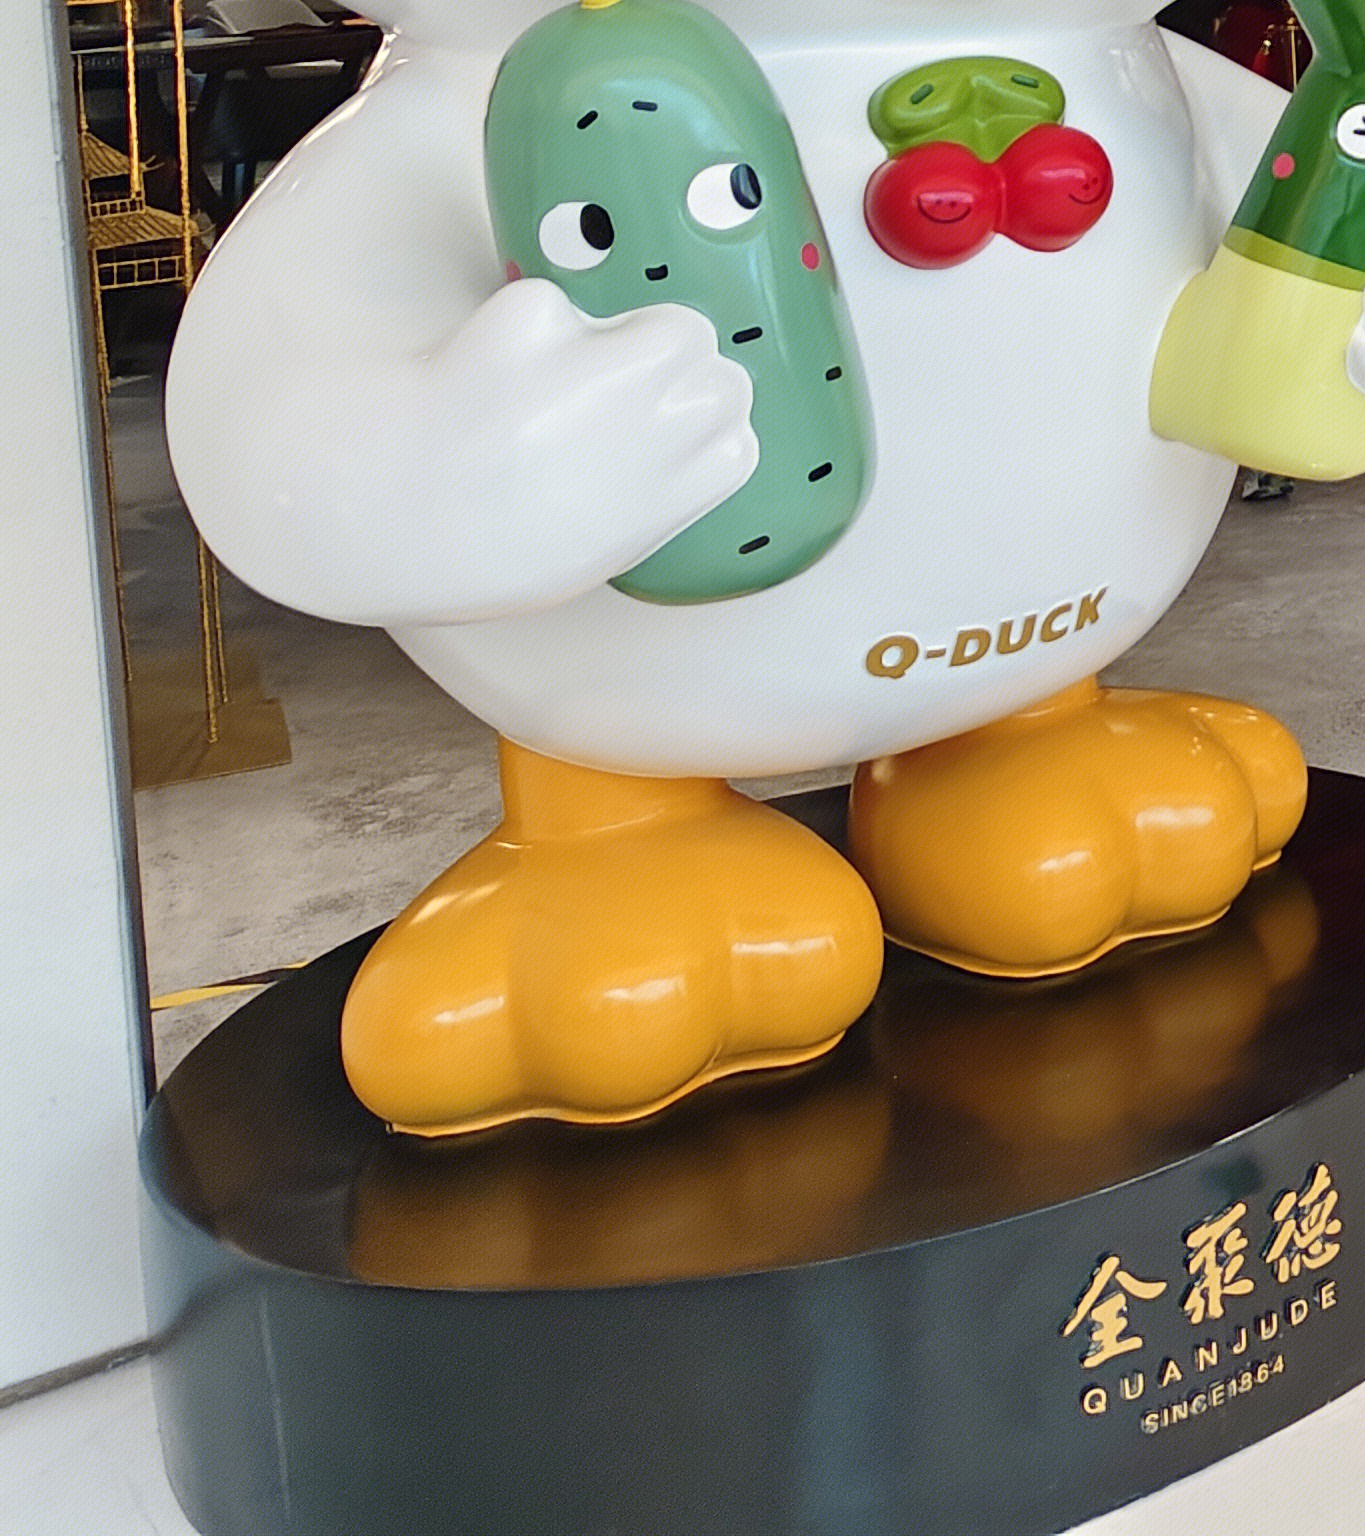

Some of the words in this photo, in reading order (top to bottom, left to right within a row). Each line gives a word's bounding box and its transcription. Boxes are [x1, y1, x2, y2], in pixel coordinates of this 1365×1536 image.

[865, 585, 1108, 680] Q-DUCK
[1062, 1163, 1342, 1368] 全聚德
[1082, 1280, 1338, 1414] QUANJUDE
